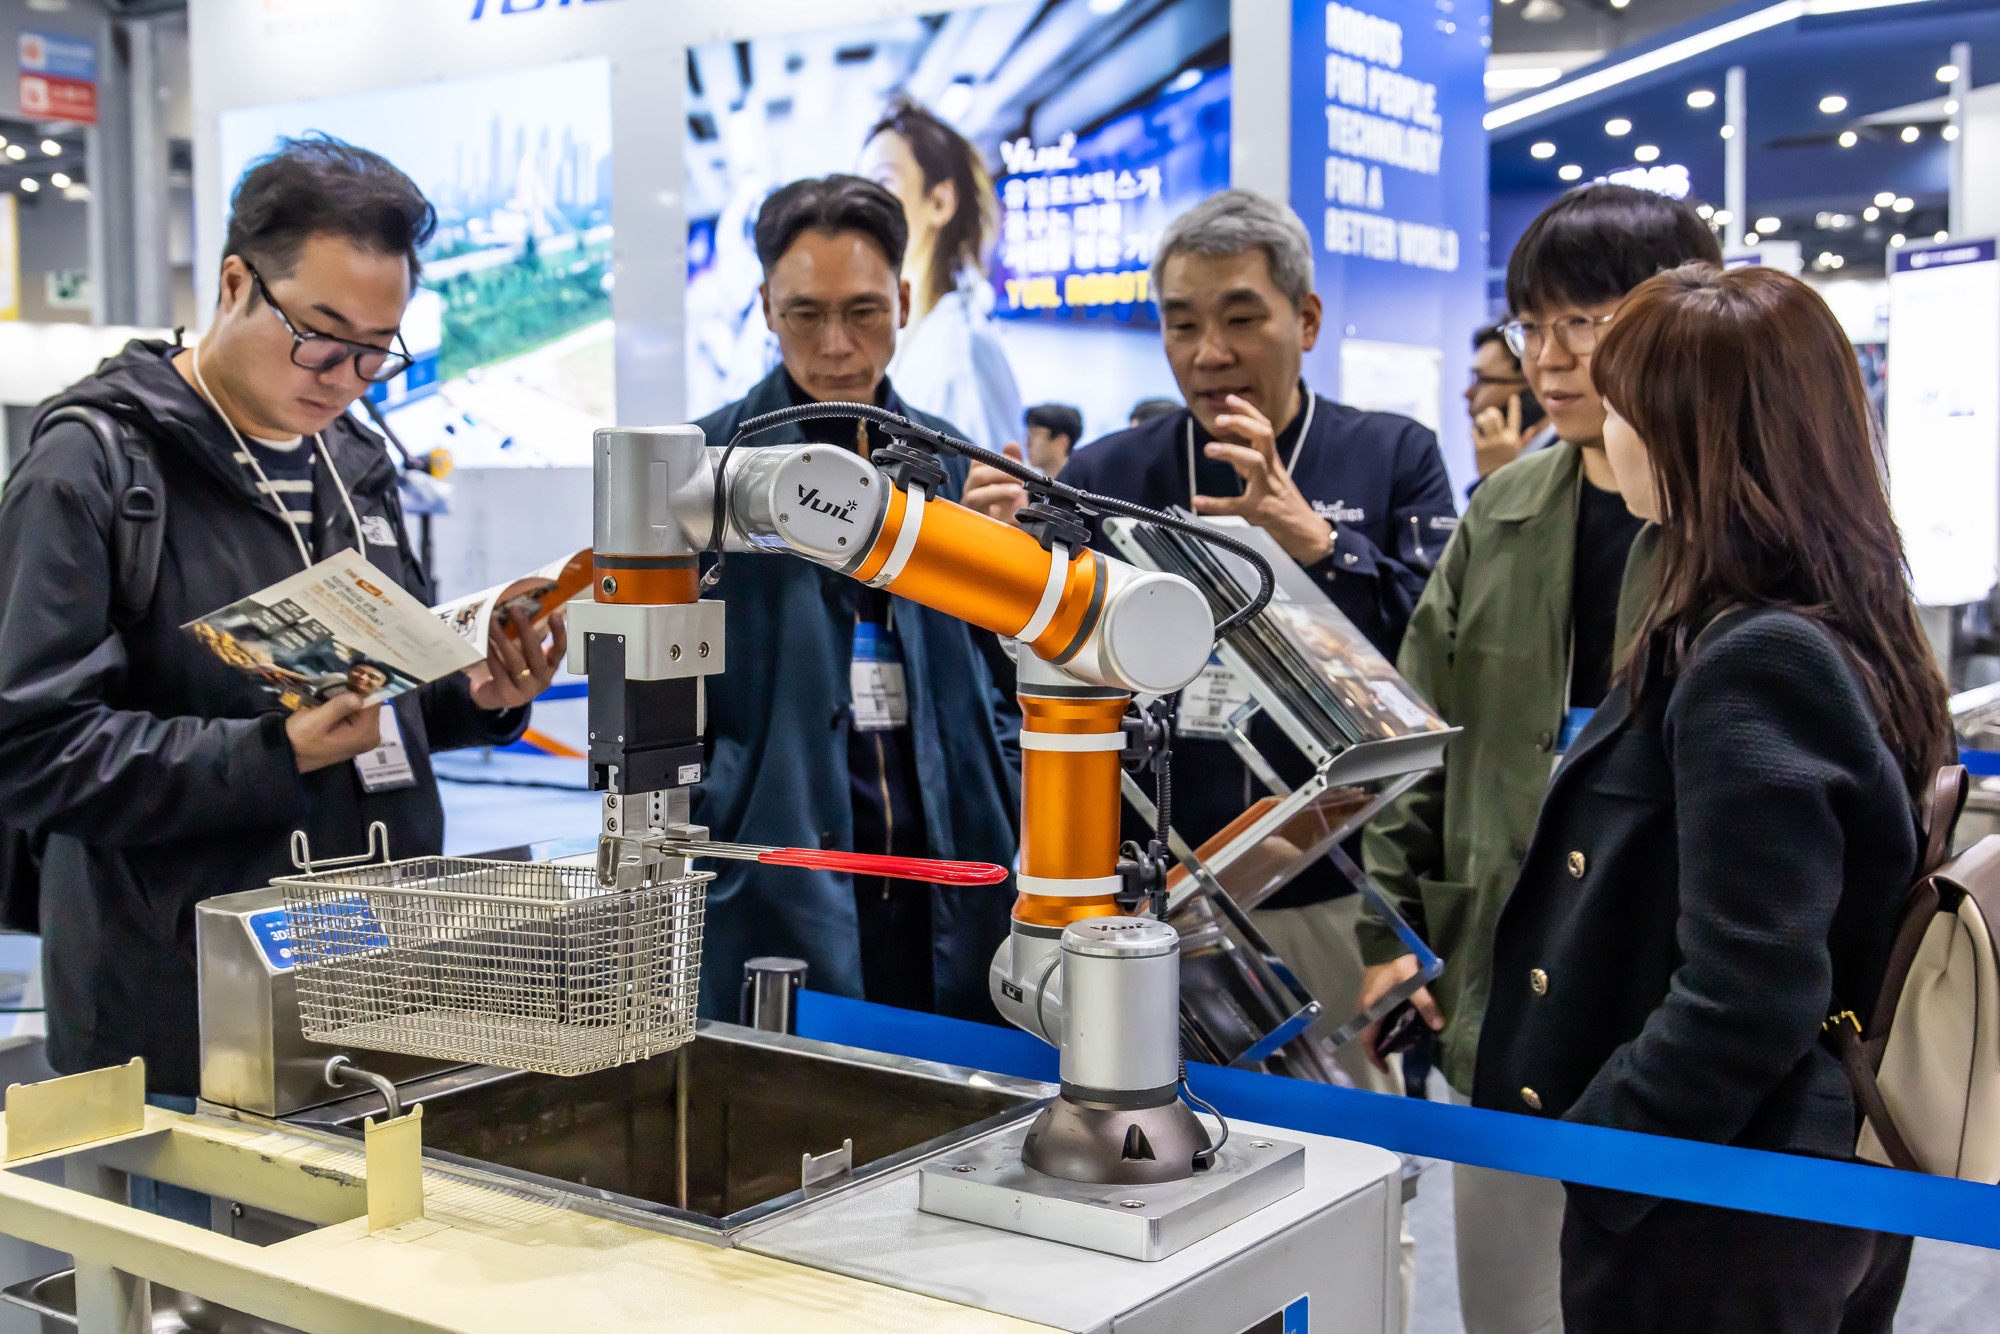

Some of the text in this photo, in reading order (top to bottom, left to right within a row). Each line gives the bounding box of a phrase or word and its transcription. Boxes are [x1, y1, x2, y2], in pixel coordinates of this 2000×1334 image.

[1326, 2, 1402, 68] ROBOTS
[1326, 53, 1366, 107] FOR
[1325, 104, 1443, 175] TECHNOLOGY
[1325, 156, 1384, 210] FOR A
[1325, 207, 1459, 271] BETTER WORLD
[1065, 270, 1154, 307] ROBOT
